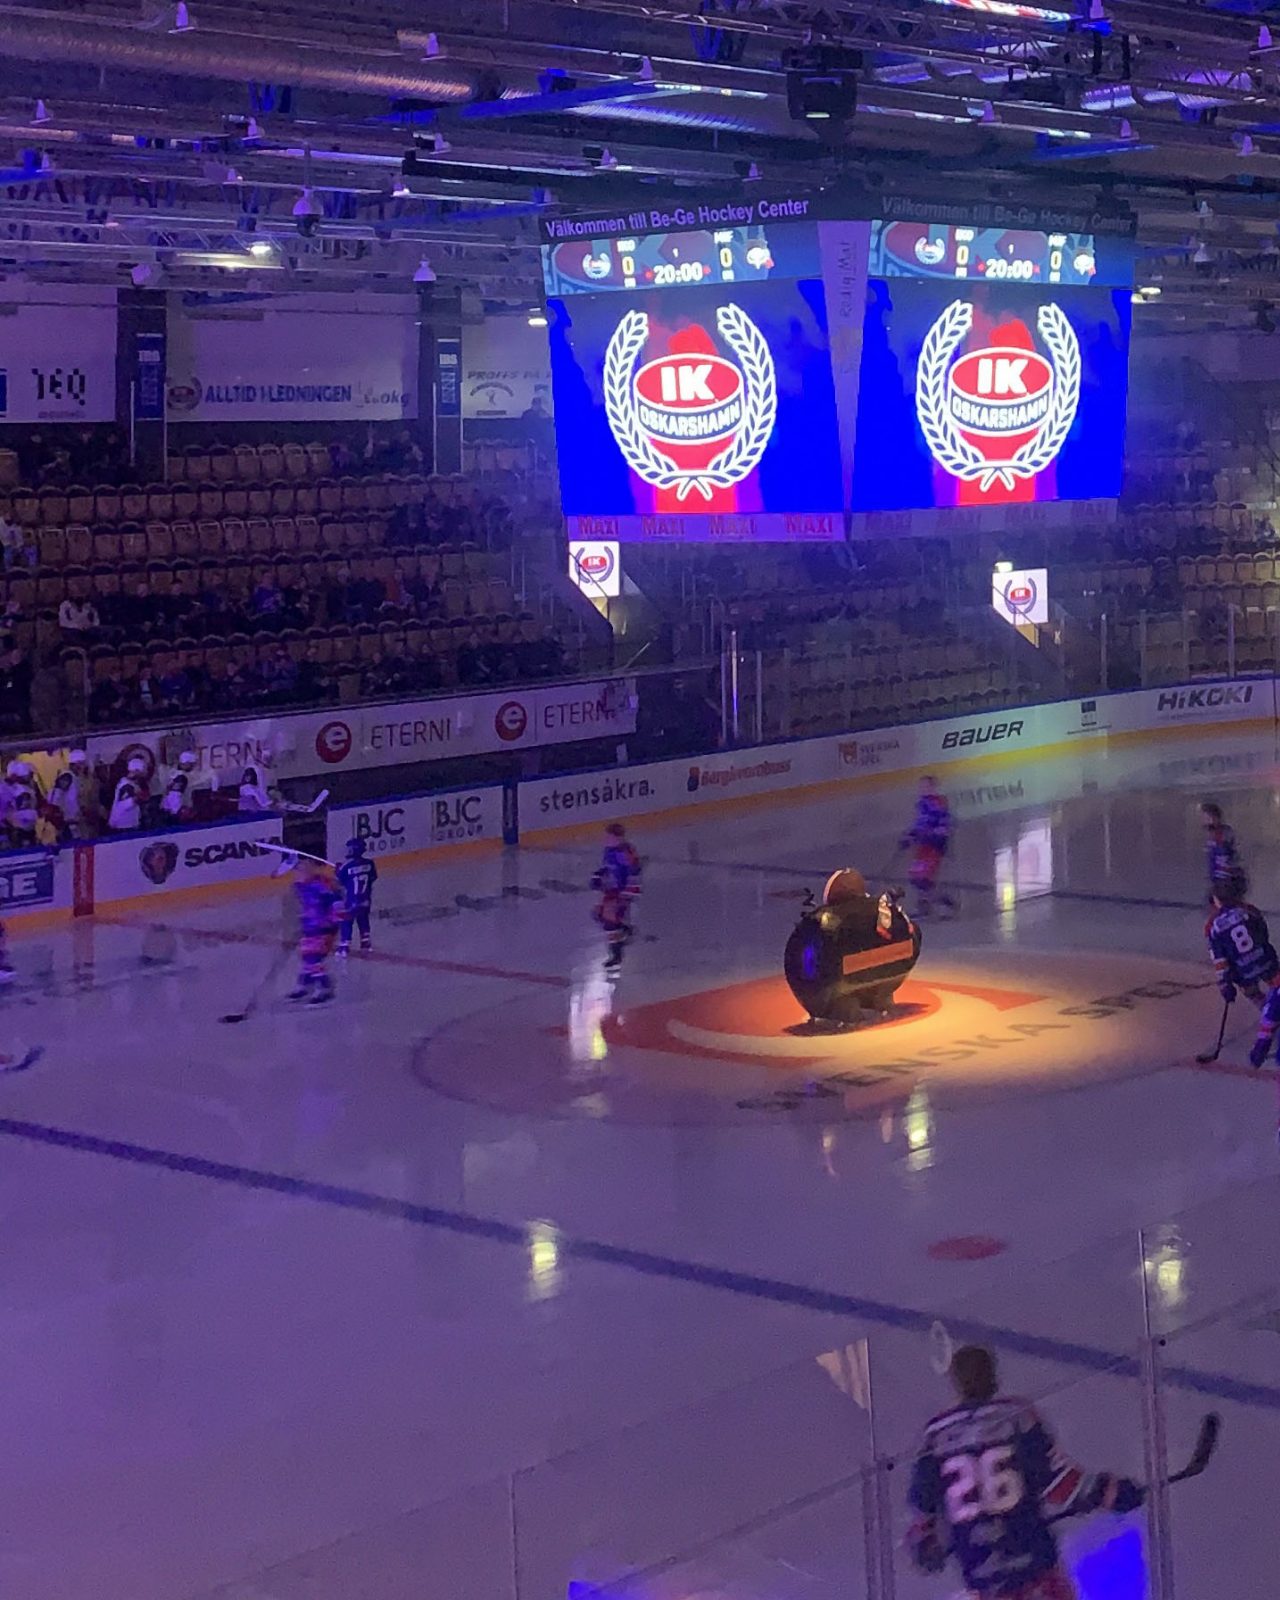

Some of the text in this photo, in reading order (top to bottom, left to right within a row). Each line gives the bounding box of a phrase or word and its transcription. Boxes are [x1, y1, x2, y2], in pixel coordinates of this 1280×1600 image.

[545, 199, 809, 238] Välkommen till Be-Ge Hockey Center
[653, 261, 704, 284] 20:00
[985, 258, 1033, 279] 20:00
[660, 364, 715, 402] IK
[977, 358, 1029, 394] IK
[205, 385, 257, 403] ALLTID
[268, 384, 351, 403] LEDNINGEN
[639, 400, 740, 436] OSKARSHAMN
[951, 394, 1048, 428] OSKARSHAMN
[543, 697, 618, 728] ETERN
[539, 776, 656, 813] stensåkra.
[356, 807, 405, 840] BJC
[436, 796, 482, 828] BJC
[367, 835, 406, 852] ROUP
[352, 873, 369, 895] 17
[1230, 924, 1253, 953] 8
[940, 1445, 1024, 1525] 26
